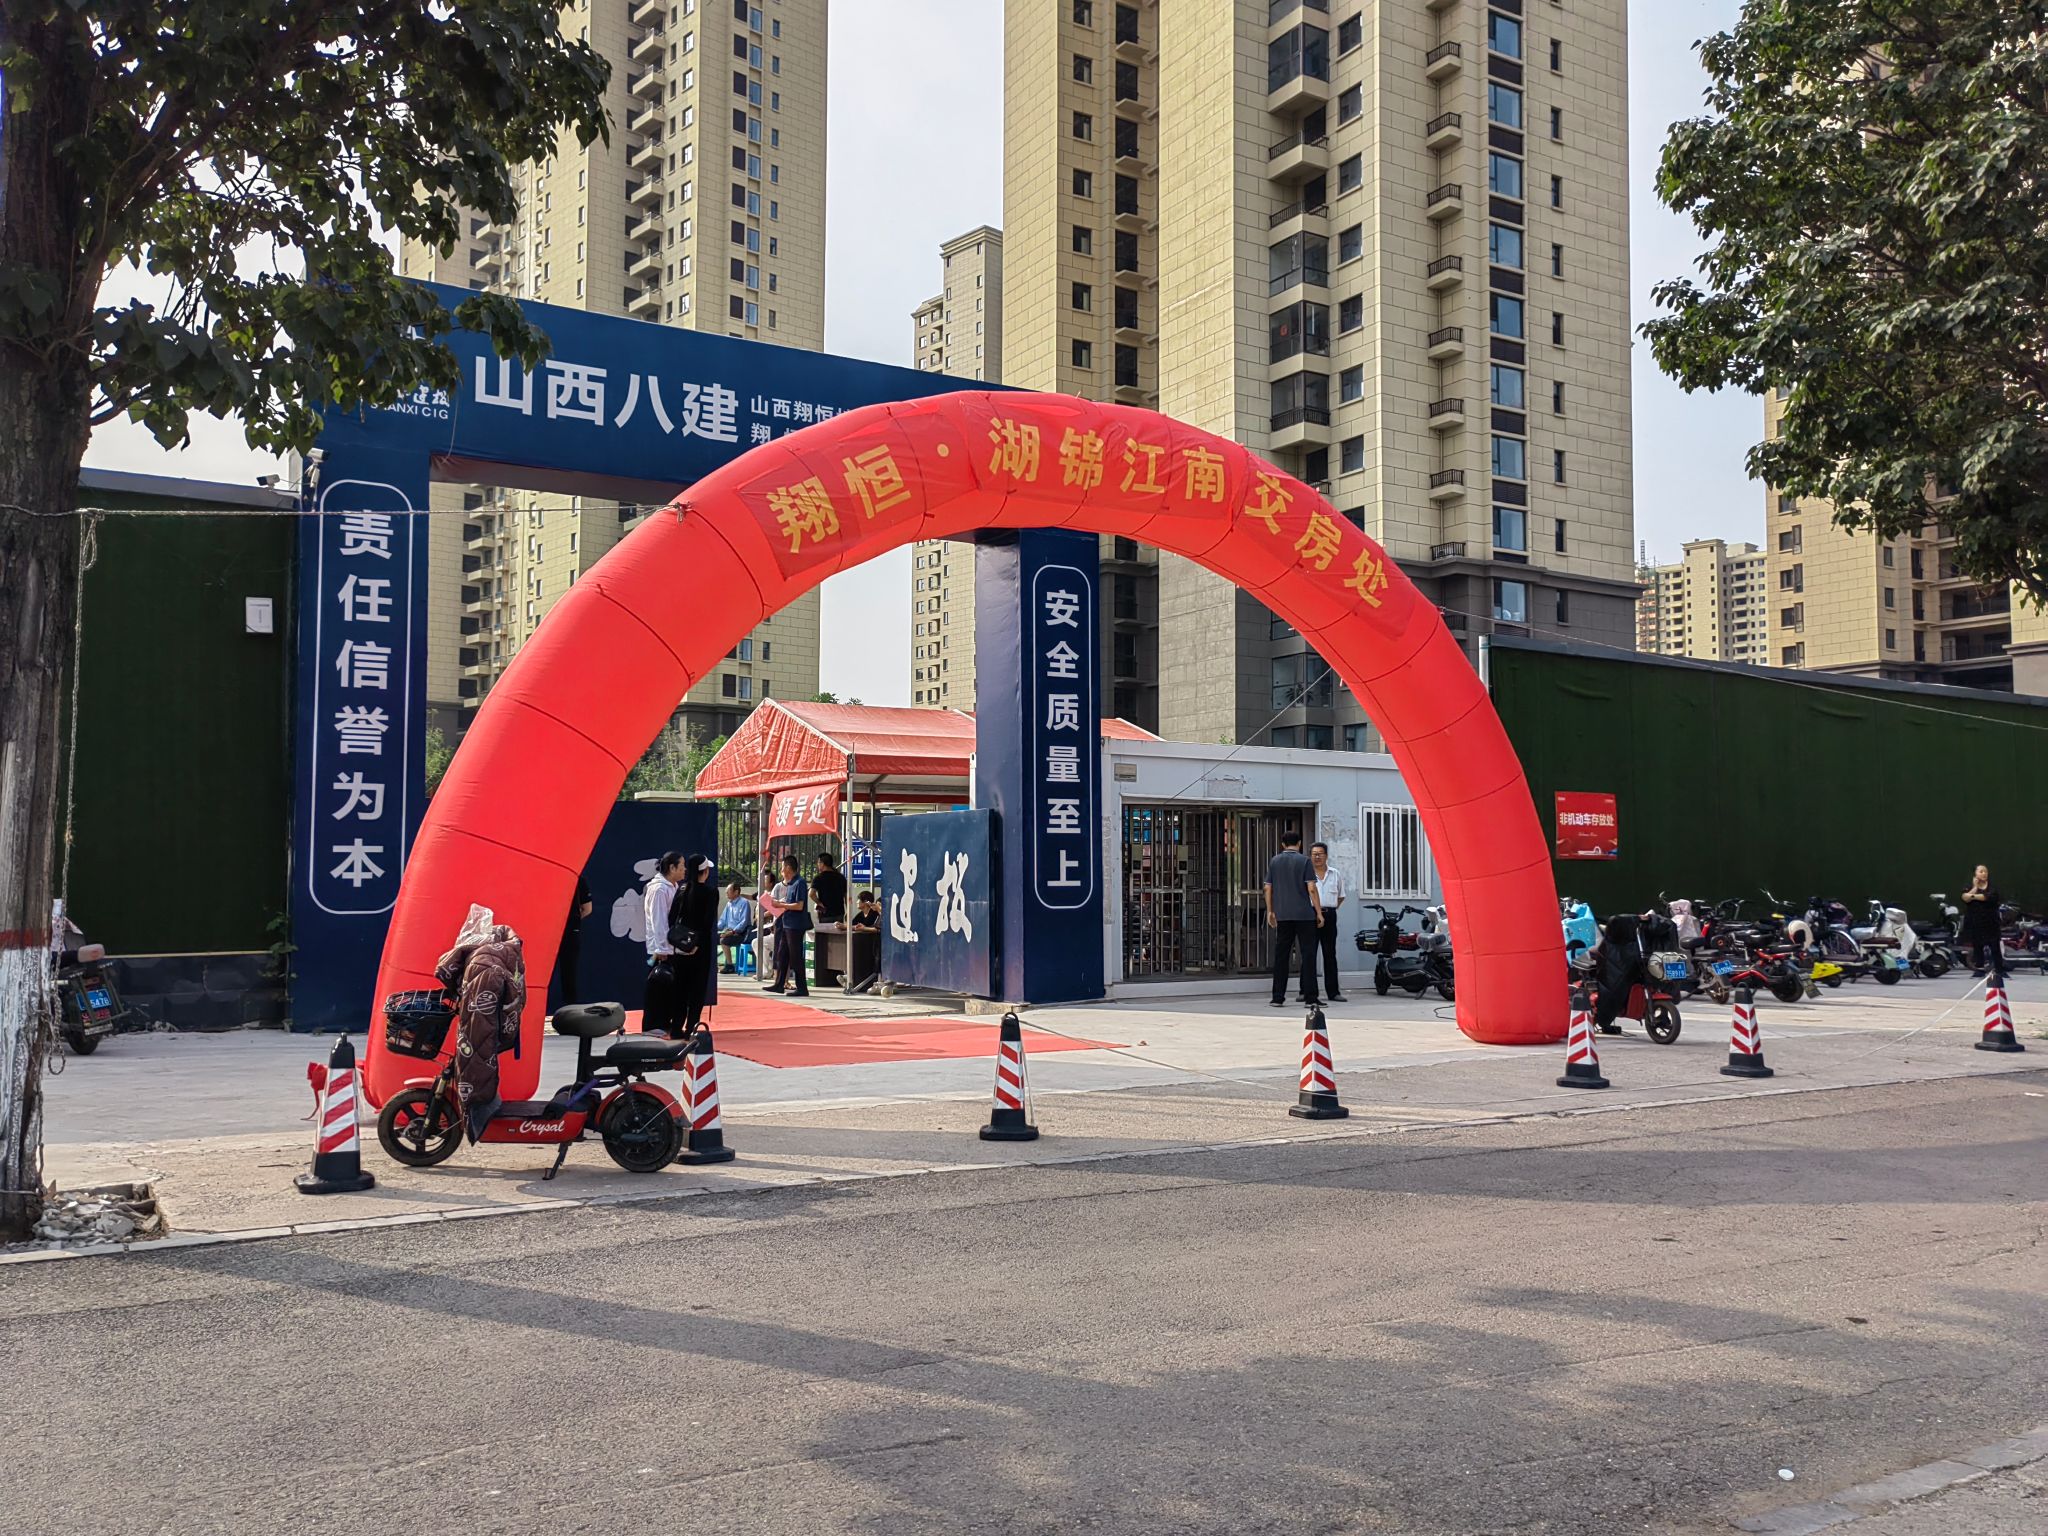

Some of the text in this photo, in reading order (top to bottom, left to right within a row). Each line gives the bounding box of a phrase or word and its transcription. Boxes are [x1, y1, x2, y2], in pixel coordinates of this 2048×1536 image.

[475, 356, 739, 443] 山西八建
[330, 510, 394, 888] 责任信誉为本
[1045, 589, 1081, 887] 安全质量至上
[775, 792, 827, 827] 领号处
[519, 1119, 566, 1136] Crysal
